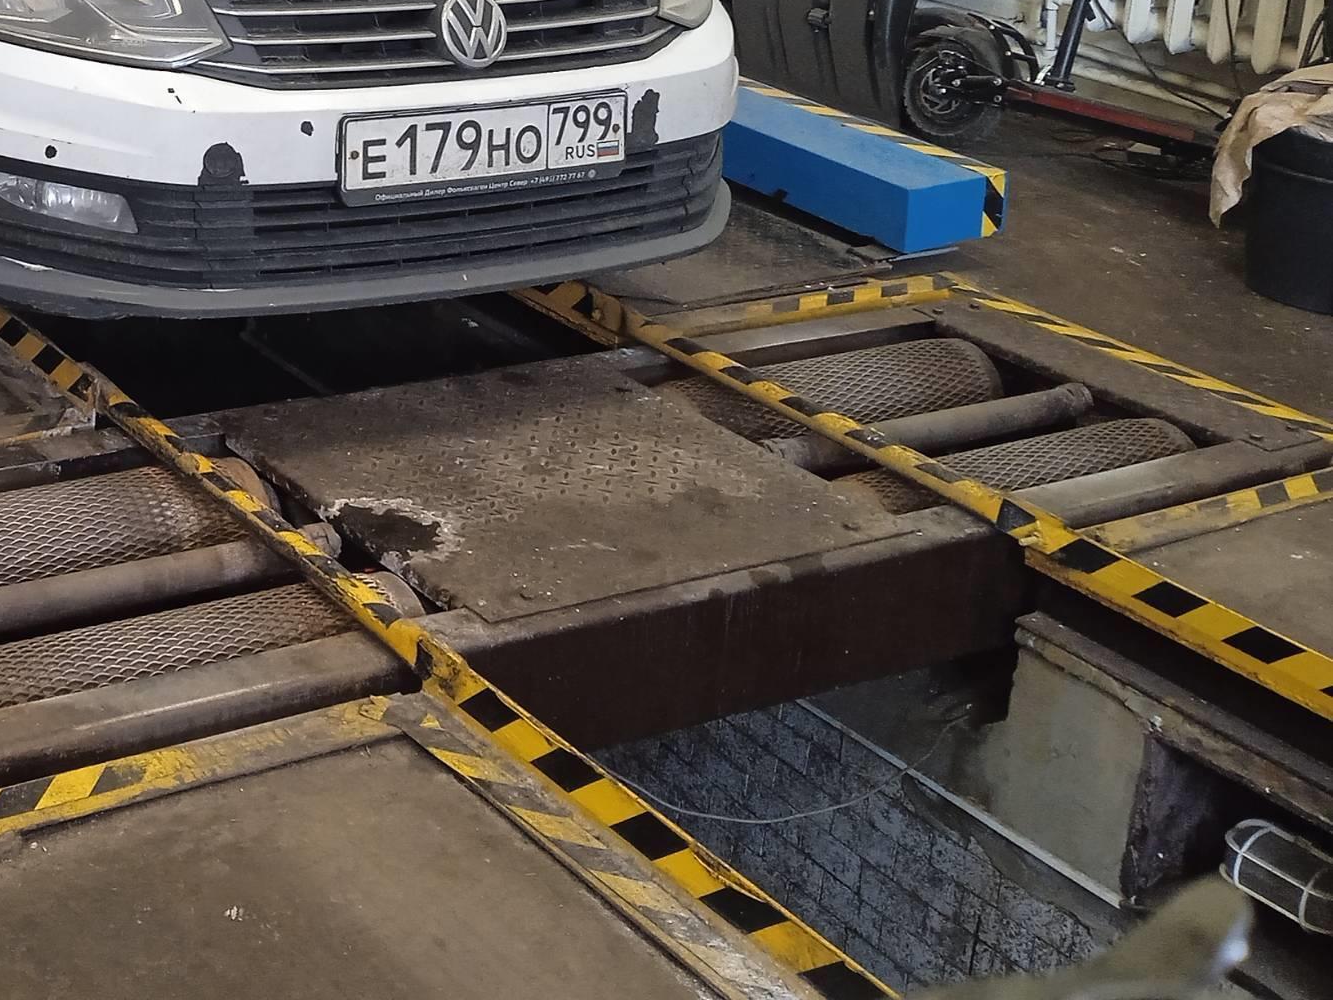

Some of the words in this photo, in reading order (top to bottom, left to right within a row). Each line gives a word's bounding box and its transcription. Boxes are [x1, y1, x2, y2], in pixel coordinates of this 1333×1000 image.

[551, 101, 613, 146] 799
[362, 119, 542, 180] Е179НО
[566, 144, 596, 160] RUS
